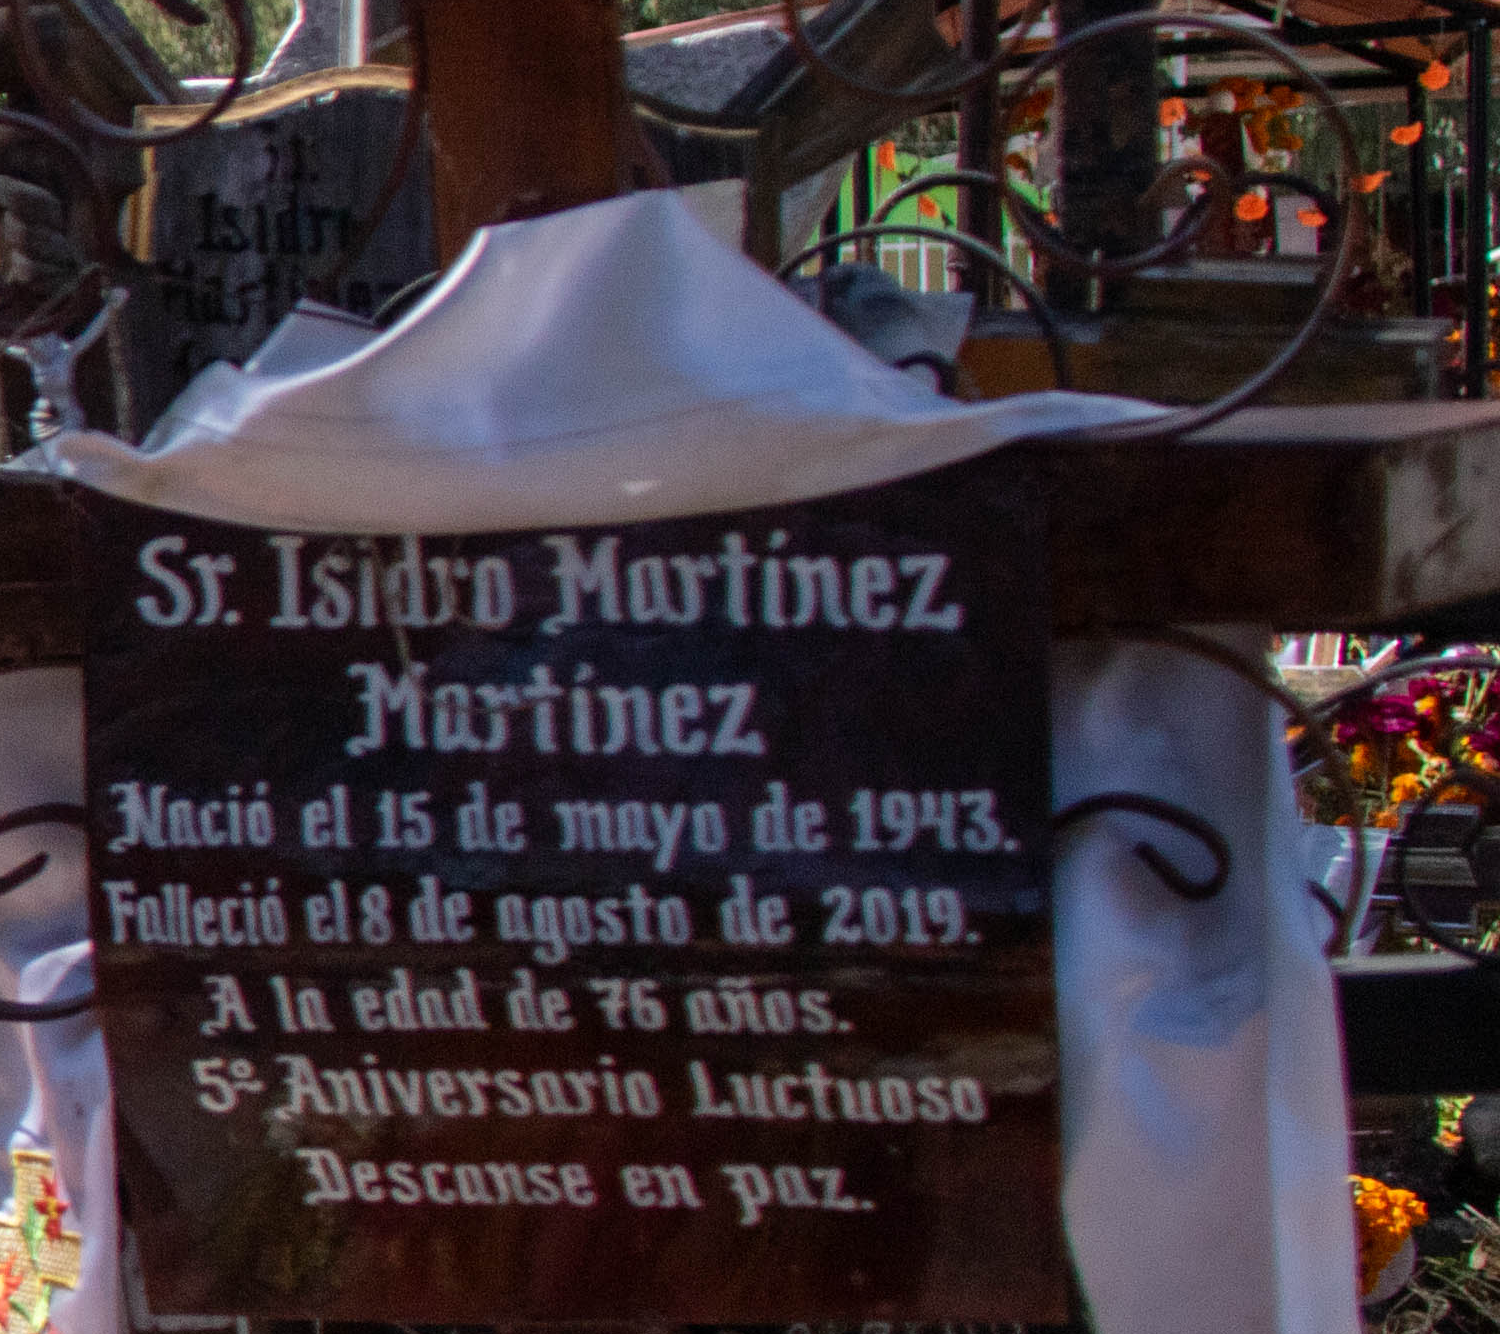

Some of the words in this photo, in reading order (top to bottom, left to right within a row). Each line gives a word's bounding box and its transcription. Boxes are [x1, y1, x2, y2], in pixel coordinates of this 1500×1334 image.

[135, 535, 243, 629] Sr.
[268, 534, 515, 629] Isidro
[540, 530, 966, 636] Martínez
[344, 661, 768, 759] Martínez
[107, 780, 276, 854] Nació
[301, 783, 351, 849] el
[375, 789, 437, 851] 15
[457, 780, 528, 852] de
[552, 797, 728, 873] mayo
[753, 780, 830, 852] de
[848, 787, 1022, 854] 1943.
[102, 877, 291, 947] Falleció
[304, 878, 352, 944] el
[358, 884, 395, 946] 8
[408, 873, 477, 943] de
[495, 882, 694, 966] agosto
[719, 873, 797, 945] de
[820, 883, 983, 946] 2019.
[199, 974, 257, 1036] A
[269, 975, 336, 1034] la
[351, 967, 492, 1033] edad
[506, 967, 577, 1032] de
[588, 977, 669, 1032] 76
[684, 975, 856, 1035] años.
[266, 1053, 663, 1122] Aniversario
[688, 1059, 987, 1124] Luctuoso
[294, 1147, 599, 1207] Descanse
[621, 1165, 706, 1211] en
[721, 1164, 878, 1229] paz.
